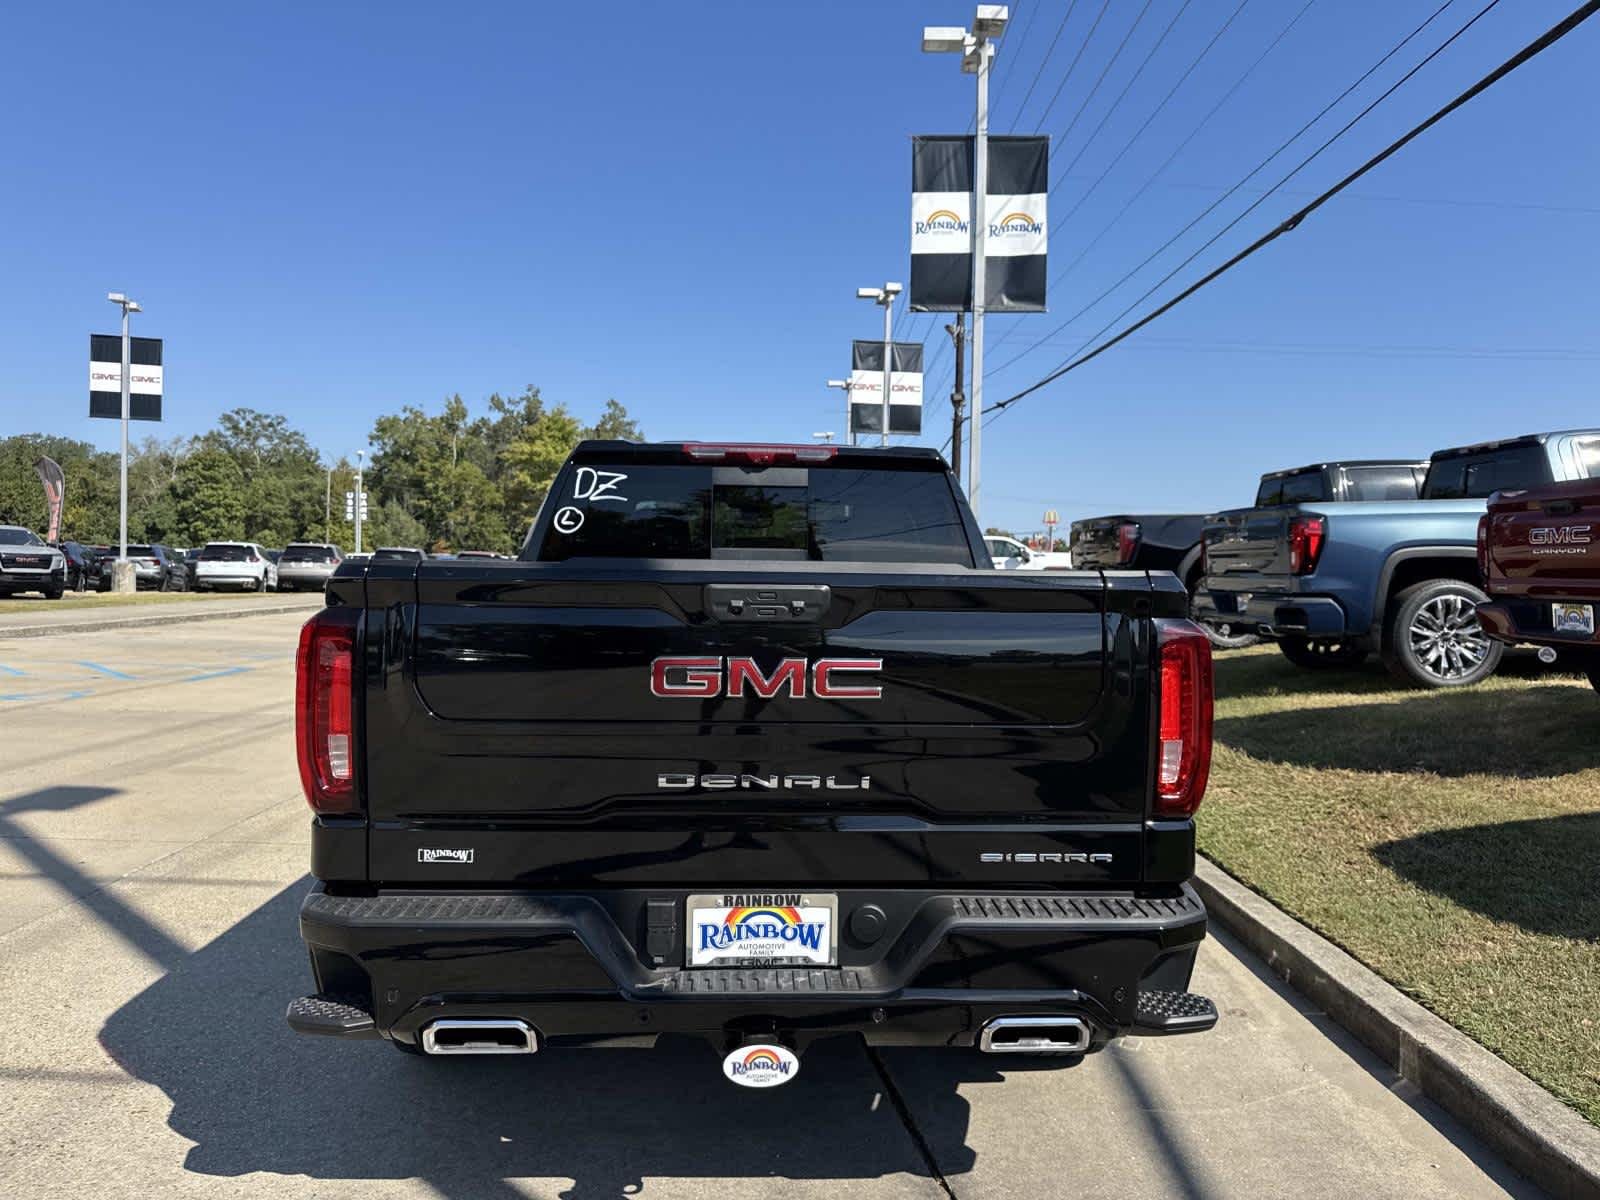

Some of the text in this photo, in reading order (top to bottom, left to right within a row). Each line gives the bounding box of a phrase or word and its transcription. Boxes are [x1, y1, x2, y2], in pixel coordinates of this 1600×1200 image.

[915, 220, 970, 234] RAINBOW
[989, 222, 1044, 237] RAINBOW
[92, 373, 121, 381] GMC
[131, 376, 160, 384] GMC
[853, 384, 881, 392] GMC
[892, 385, 920, 393] GMC
[1529, 526, 1590, 544] GMC
[650, 656, 883, 699] GMC
[657, 774, 871, 790] DENALI
[423, 849, 468, 862] RAINBOW
[980, 853, 1112, 863] SIERRA
[723, 895, 801, 907] RAINBOW
[701, 922, 824, 951] RAINBOW
[731, 1061, 791, 1076] RAINBOW
